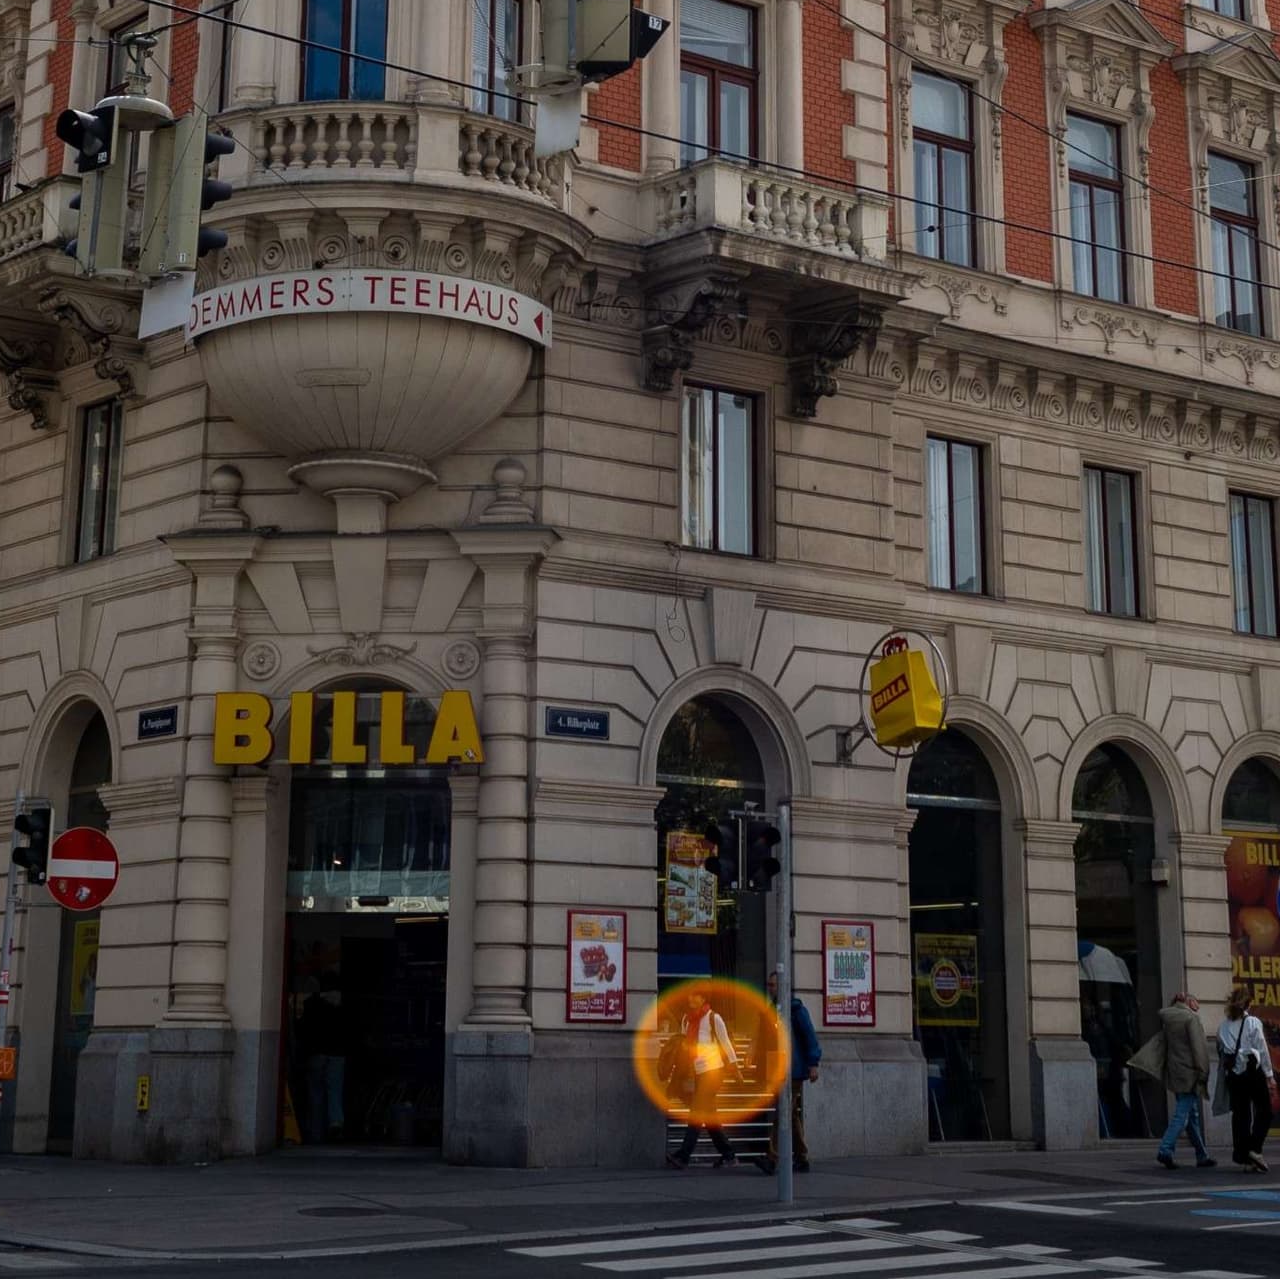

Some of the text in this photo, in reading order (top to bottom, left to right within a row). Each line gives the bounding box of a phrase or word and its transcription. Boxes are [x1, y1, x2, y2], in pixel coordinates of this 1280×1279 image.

[651, 17, 661, 28] 17
[363, 276, 519, 326] TEEHAUS
[874, 678, 907, 710] BILLA
[214, 690, 485, 766] BILLA
